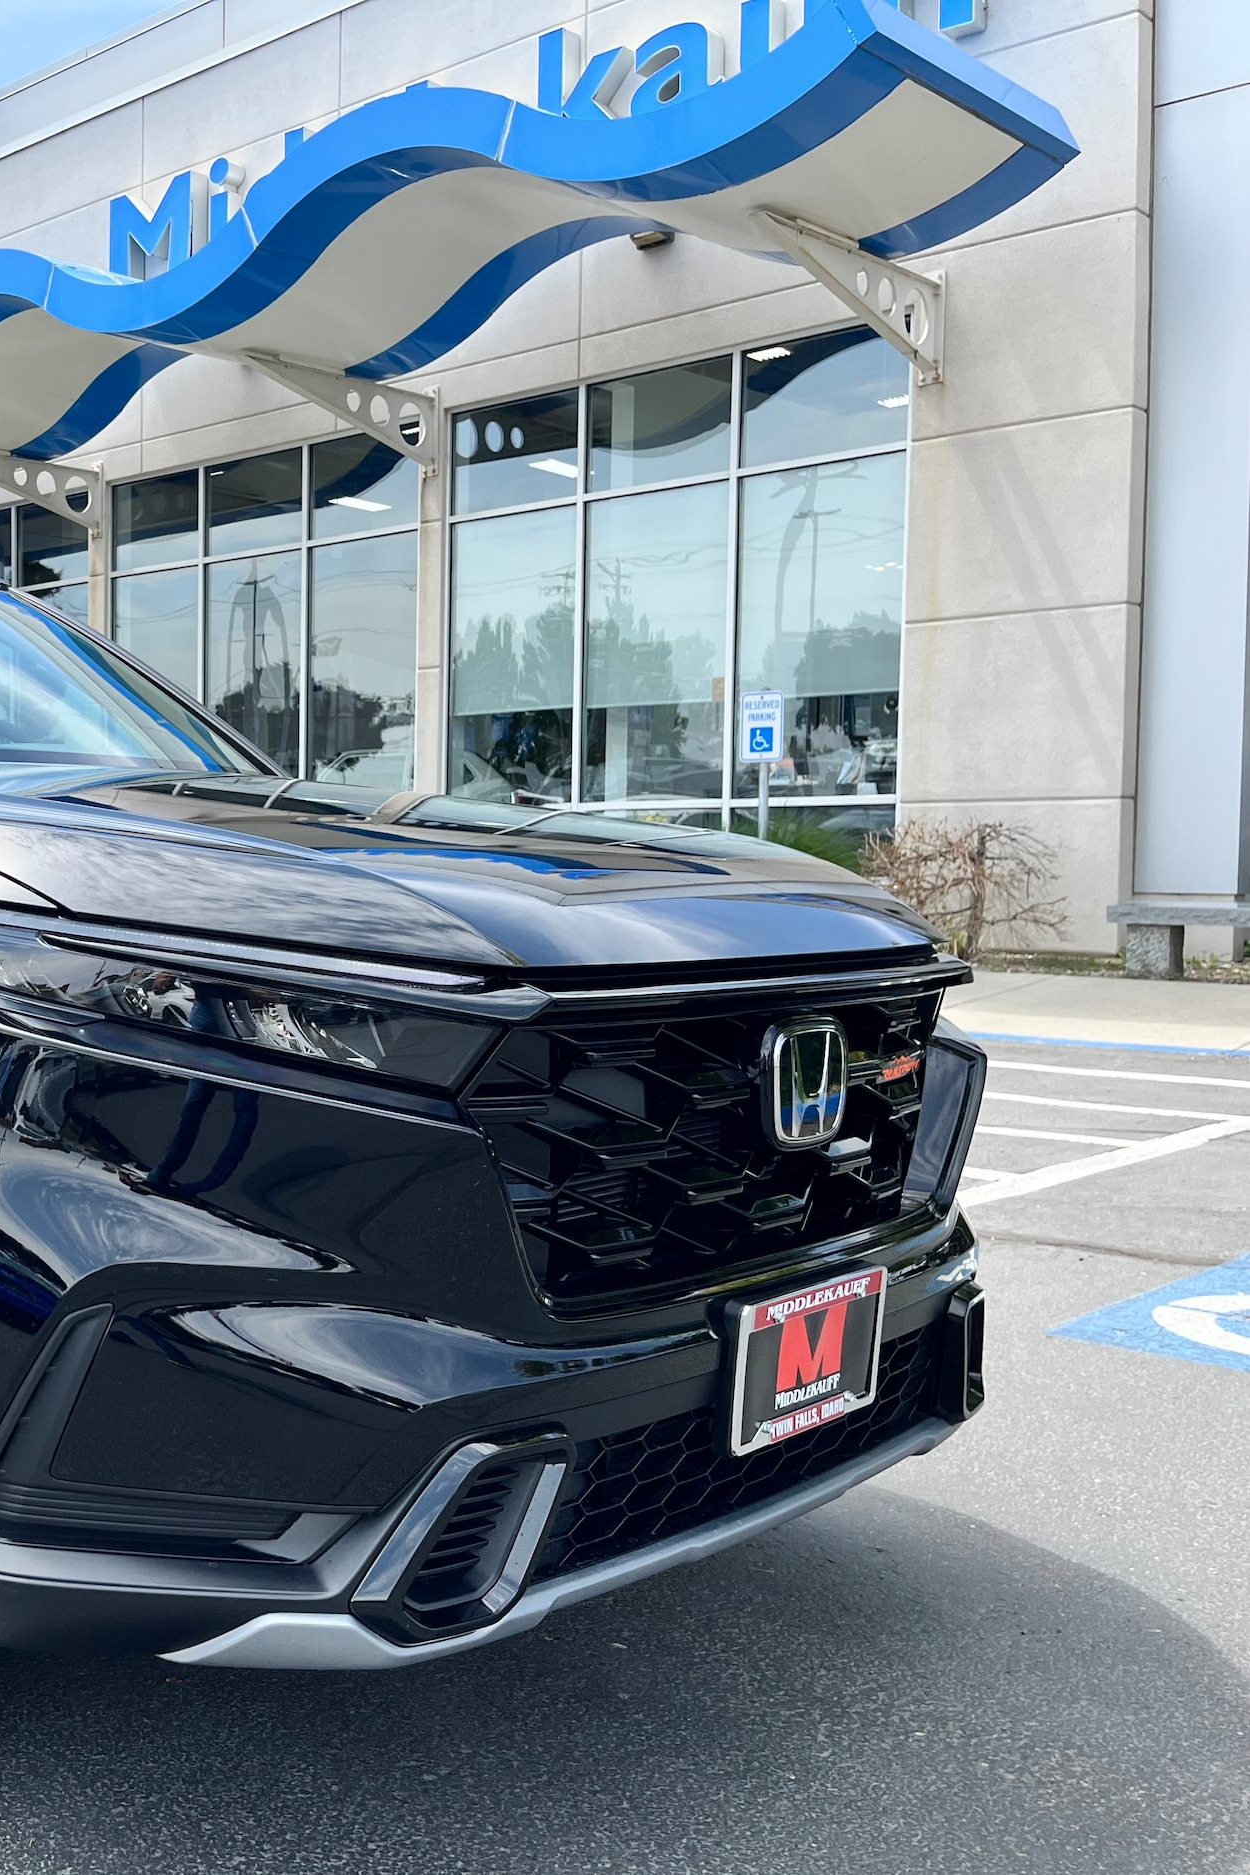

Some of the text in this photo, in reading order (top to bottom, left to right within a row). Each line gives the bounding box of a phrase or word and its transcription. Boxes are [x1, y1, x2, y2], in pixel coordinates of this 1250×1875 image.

[745, 699, 780, 710] RESERVED
[748, 712, 776, 722] PARKING
[774, 1373, 841, 1411] MIDDLEKAUFF
[771, 1397, 845, 1439] TWIN FALLS, IDAHO
